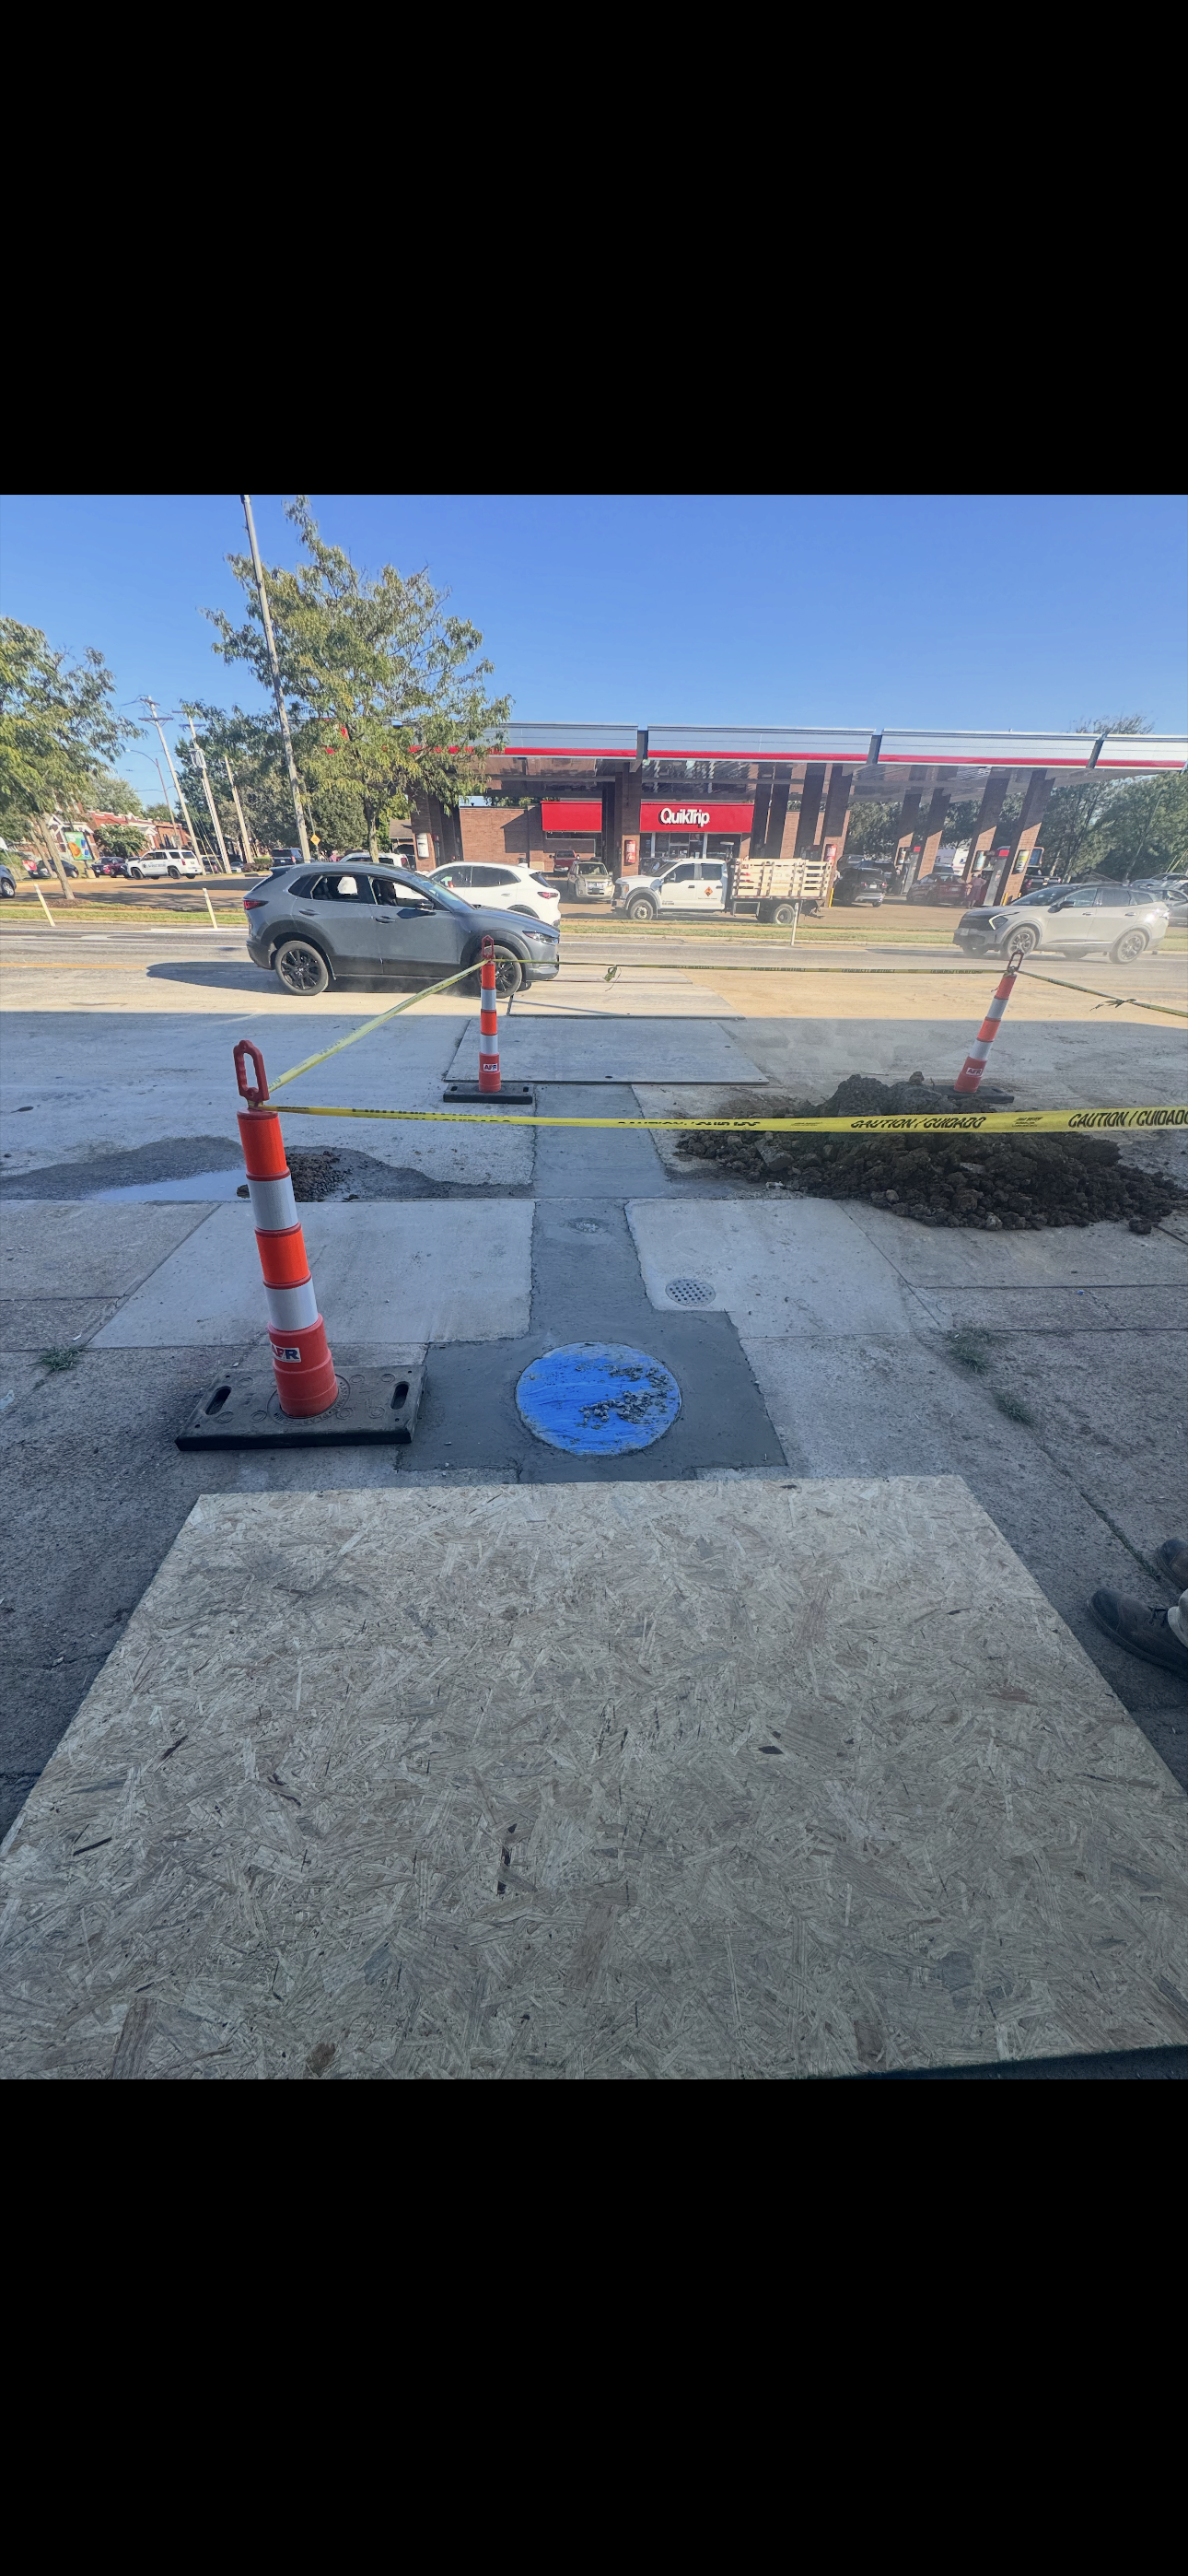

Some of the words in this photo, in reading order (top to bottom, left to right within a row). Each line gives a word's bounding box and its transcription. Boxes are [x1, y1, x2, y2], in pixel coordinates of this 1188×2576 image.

[659, 807, 710, 827] QuikTrip
[850, 1118, 917, 1129] CAUTION
[923, 1116, 987, 1129] CUIDADO
[1068, 1111, 1130, 1128] CAUTION
